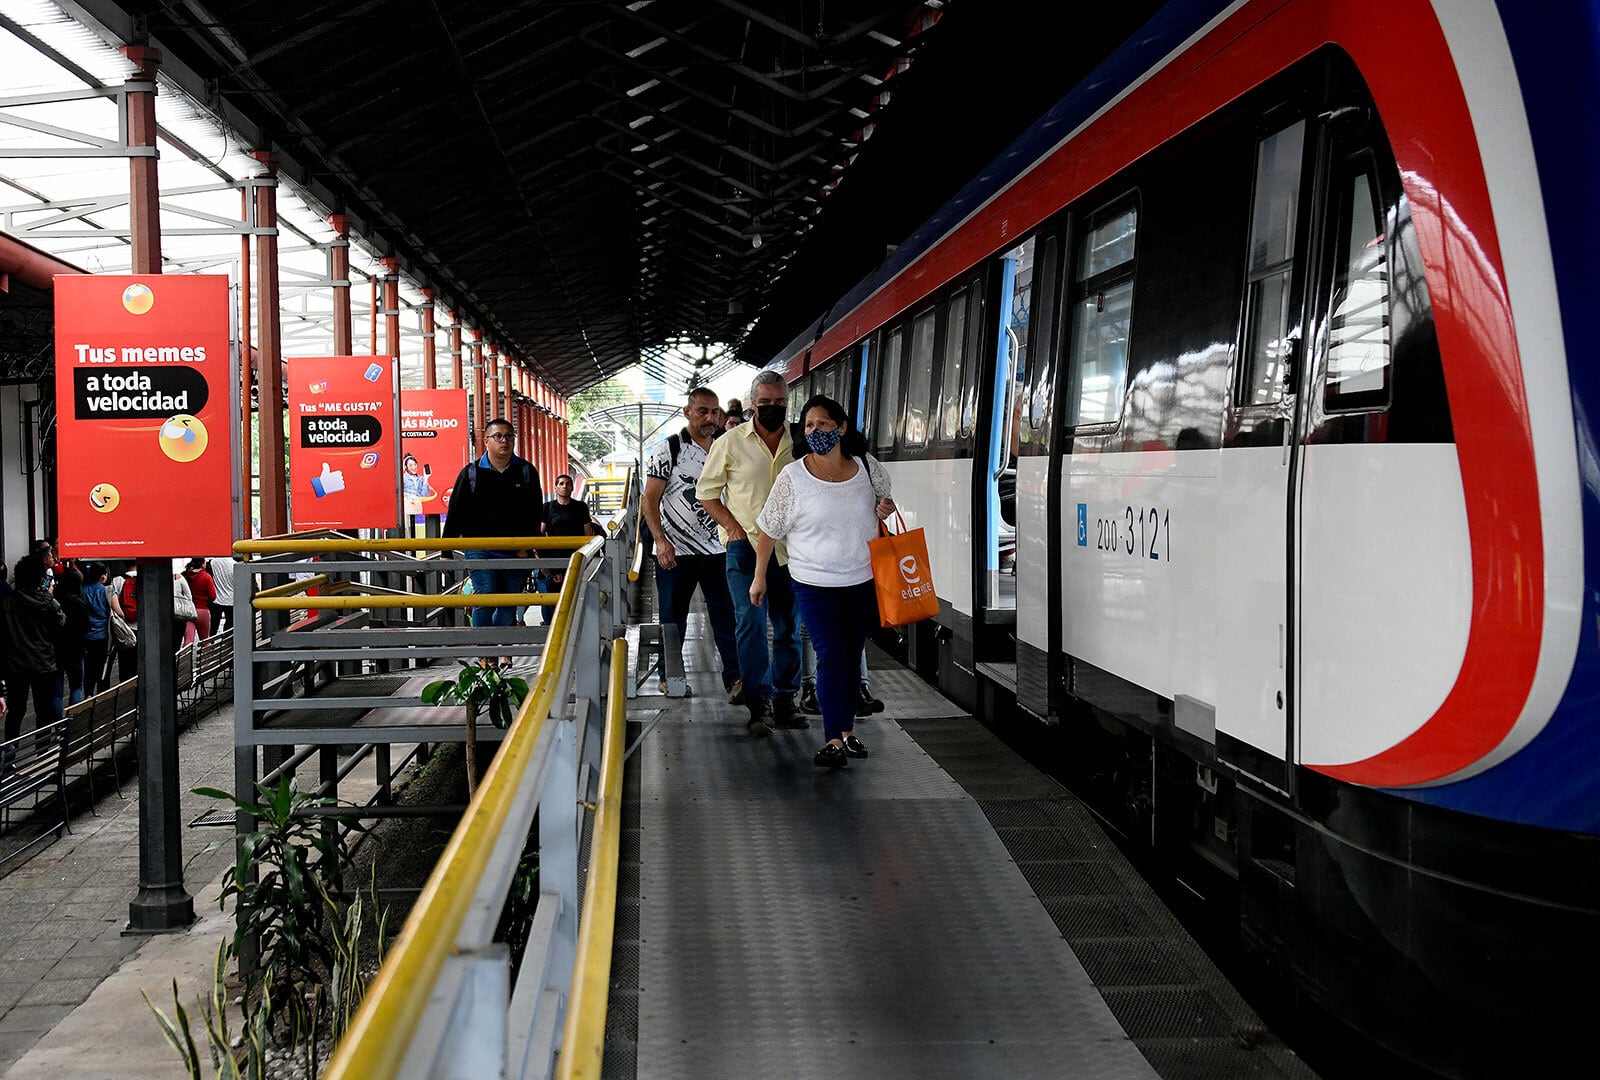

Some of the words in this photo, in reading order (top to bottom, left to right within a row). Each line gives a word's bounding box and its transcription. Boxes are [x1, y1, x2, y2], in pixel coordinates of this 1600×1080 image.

[74, 344, 117, 363] Tus
[121, 346, 206, 362] memes
[86, 376, 99, 391] a
[102, 371, 151, 391] toda
[86, 390, 188, 411] velocidad
[299, 403, 317, 412] Tus
[308, 421, 316, 431] a
[317, 418, 348, 431] toda
[419, 416, 458, 428] RÁPIDO
[308, 430, 370, 443] velocidad
